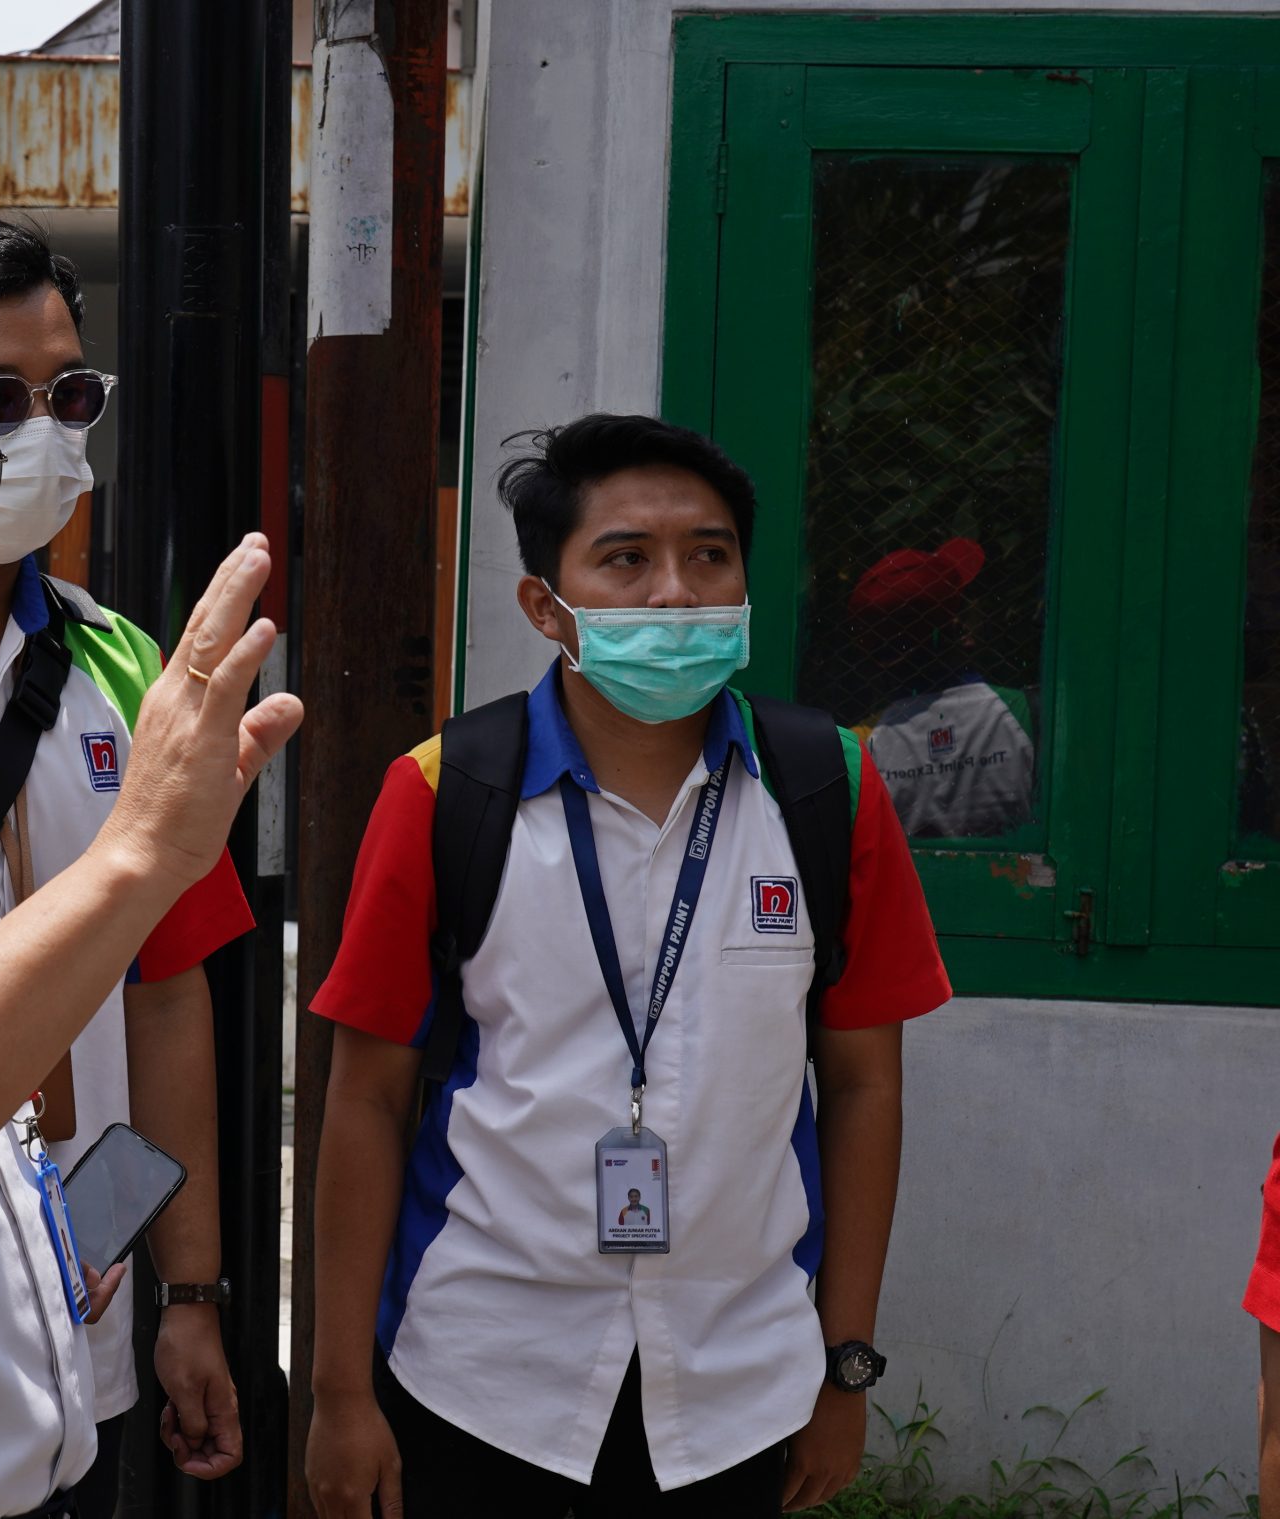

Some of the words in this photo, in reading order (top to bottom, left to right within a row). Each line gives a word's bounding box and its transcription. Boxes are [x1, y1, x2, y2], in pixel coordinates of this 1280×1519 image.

[696, 788, 719, 842] NIPPON
[654, 945, 678, 1002] NIPPON
[669, 899, 690, 944] PAINT
